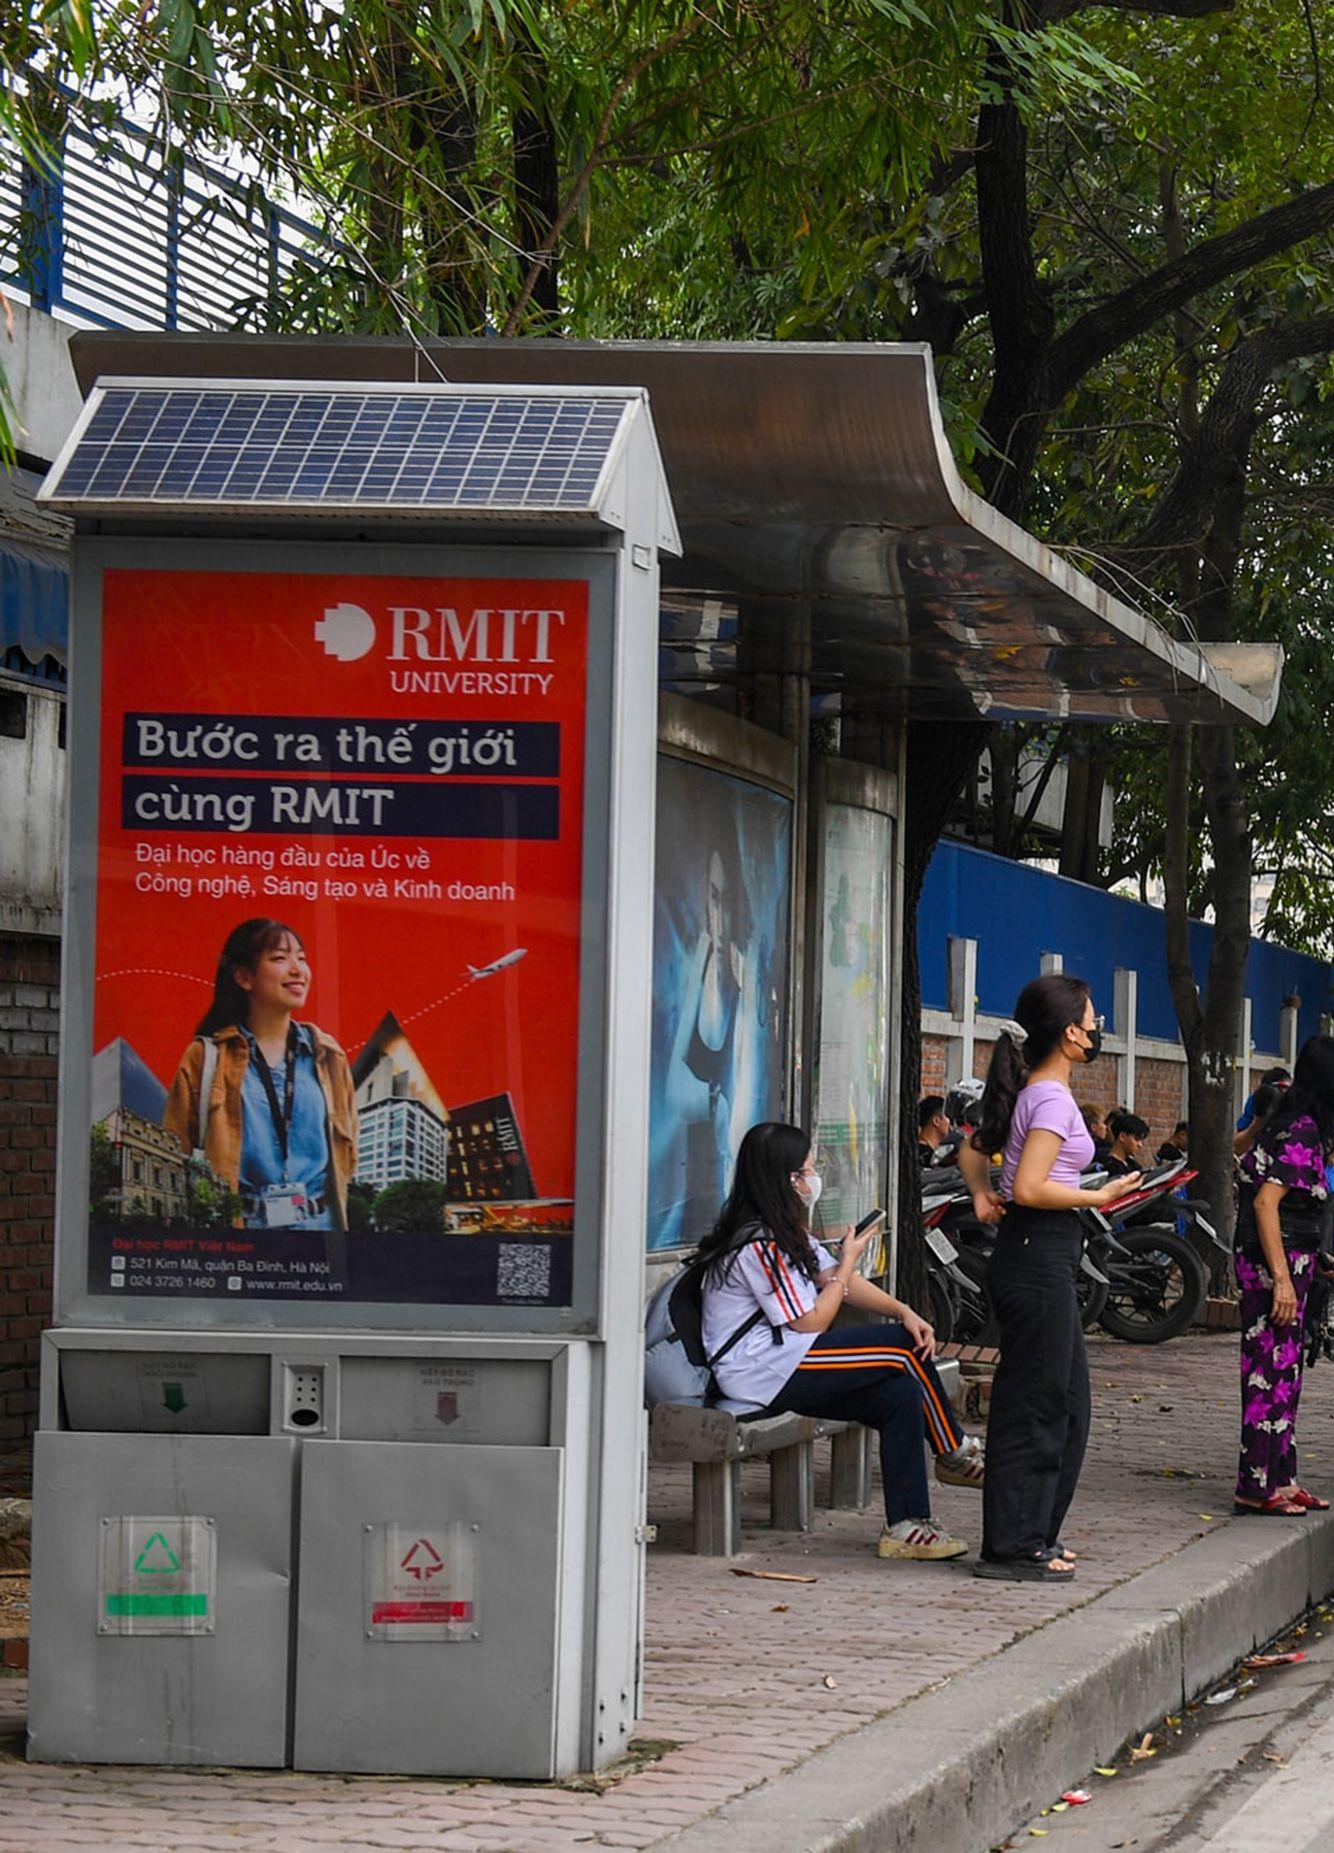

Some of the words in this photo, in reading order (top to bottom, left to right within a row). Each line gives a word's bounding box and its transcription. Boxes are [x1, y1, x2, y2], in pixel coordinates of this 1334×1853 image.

[386, 607, 565, 663] RMIT
[390, 671, 554, 695] UNIVERSITY
[136, 719, 259, 761] Bước
[274, 732, 321, 763] ra
[336, 722, 417, 764] thế
[428, 728, 517, 774] giới
[134, 784, 255, 832] cùng
[270, 786, 394, 826] RMIT
[135, 843, 171, 871] Đại
[177, 844, 214, 872] học
[222, 845, 274, 869] hàng
[280, 844, 320, 868] đầu
[326, 848, 364, 869] của
[371, 846, 399, 869] Úc
[405, 848, 430, 870] về
[135, 872, 191, 897] Công
[198, 875, 256, 900] nghệ,
[263, 876, 318, 900] Sáng
[324, 878, 356, 900] tạo
[364, 879, 388, 899] và
[394, 879, 441, 900] Kinh
[447, 880, 515, 901] doanh
[130, 1258, 151, 1269] 521
[155, 1258, 178, 1270] Kim
[238, 1261, 254, 1272] Ba
[290, 1262, 306, 1273] Hà
[130, 1275, 151, 1287] 024
[155, 1276, 184, 1287] 3726
[187, 1277, 216, 1288] 1460
[246, 1278, 343, 1292] www.rmit.edu.vn
